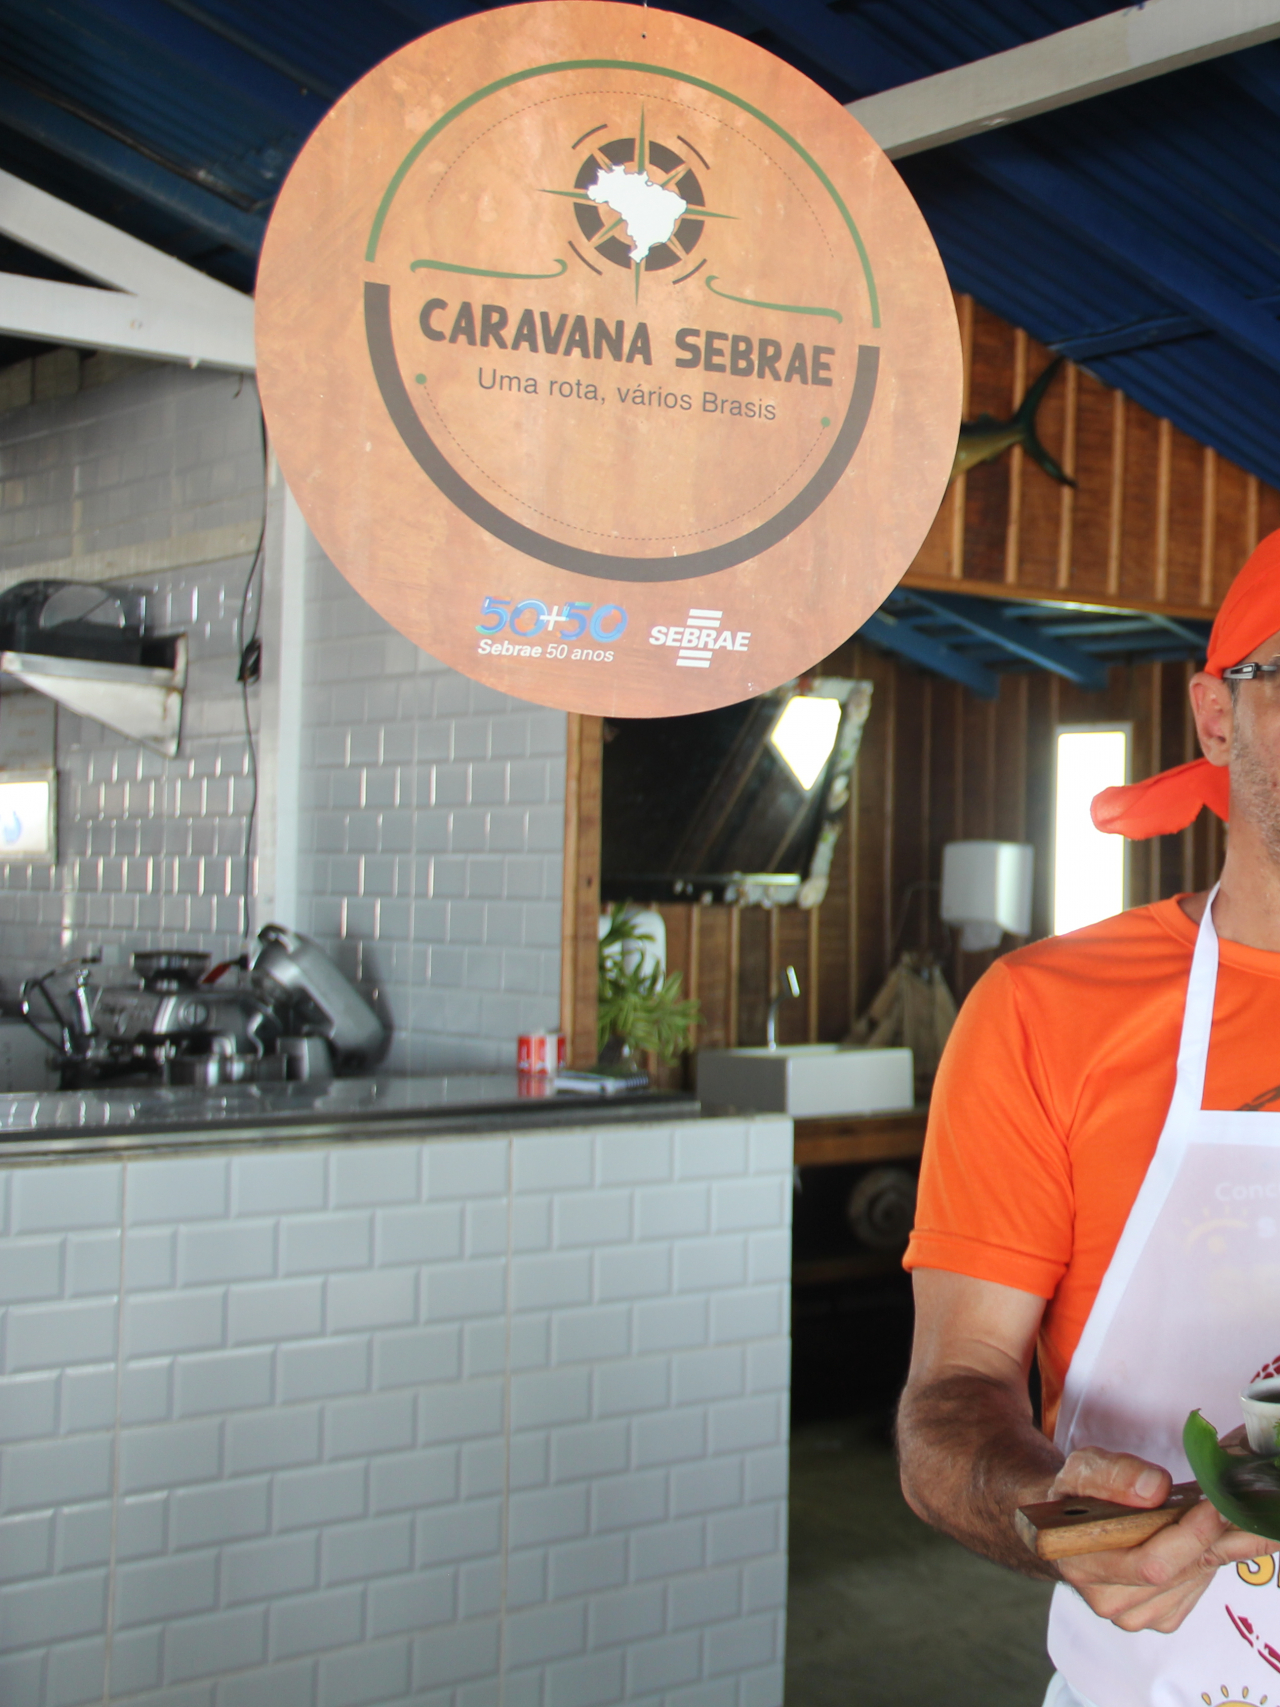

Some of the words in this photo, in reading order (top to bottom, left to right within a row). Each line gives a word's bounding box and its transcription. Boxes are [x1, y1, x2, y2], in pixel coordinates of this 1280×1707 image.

[419, 298, 653, 366] CARAVANA
[674, 328, 836, 387] SEBRAE
[477, 366, 539, 395] Uma
[549, 377, 607, 406] rota,
[617, 383, 693, 412] vários
[702, 391, 778, 421] Brasis
[474, 595, 628, 643] 50+50
[648, 626, 751, 651] SEBRAE
[477, 638, 543, 658] Sebrae
[545, 643, 568, 660] 50
[570, 647, 615, 662] anos
